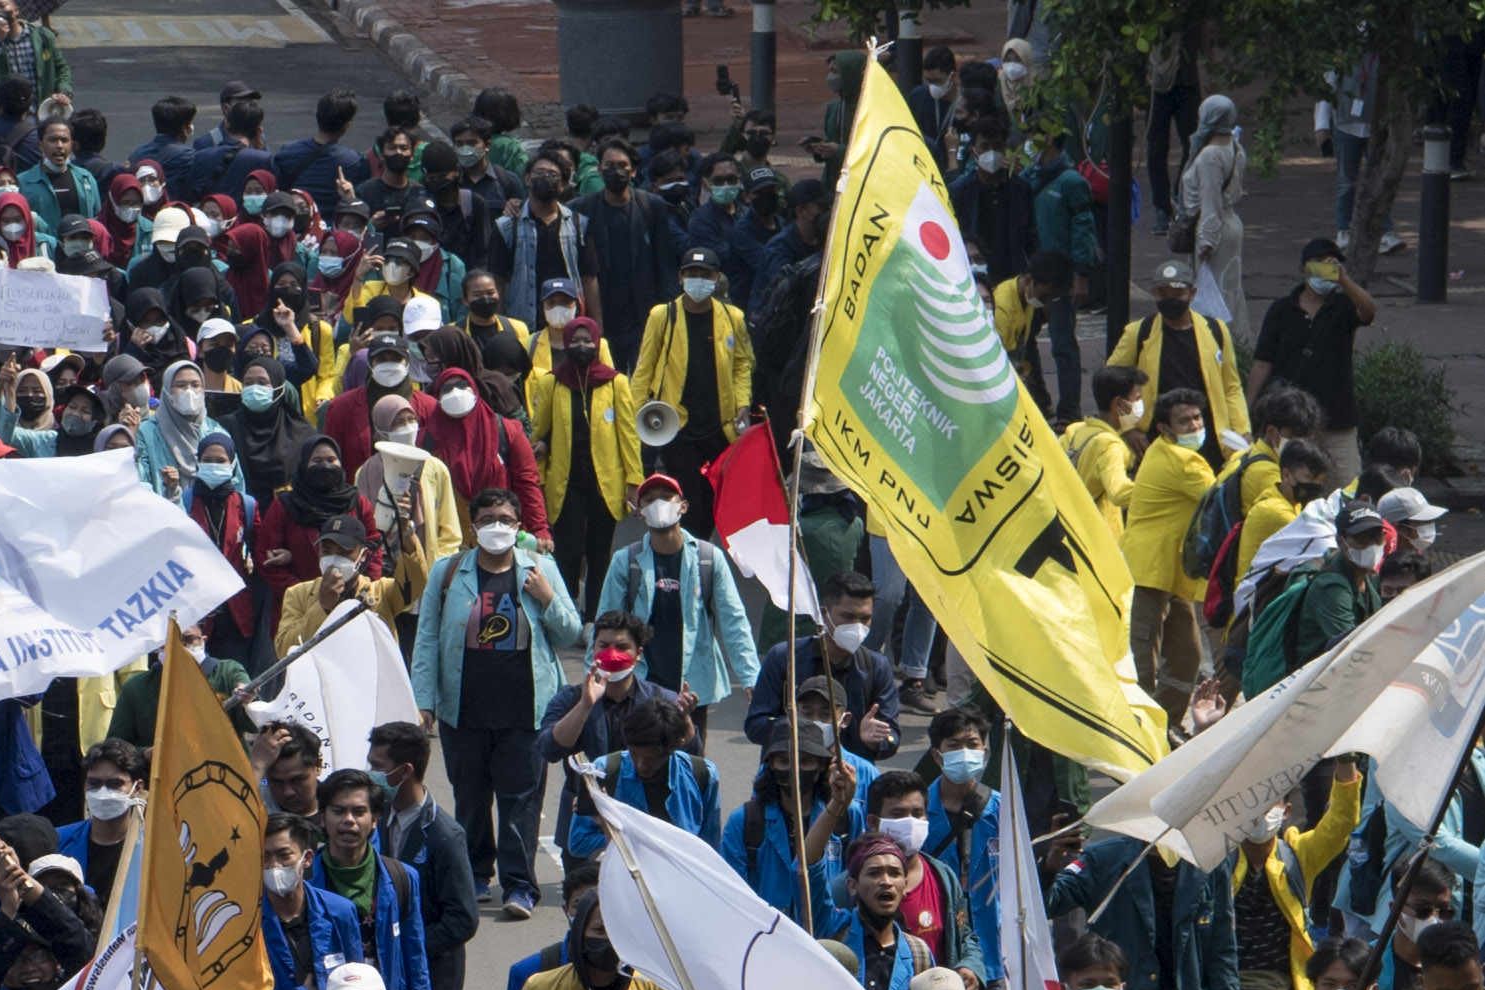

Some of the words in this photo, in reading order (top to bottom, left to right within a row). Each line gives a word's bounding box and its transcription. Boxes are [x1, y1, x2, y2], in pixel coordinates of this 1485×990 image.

[57, 19, 291, 42] MOTO
[843, 203, 891, 321] BADAN
[859, 383, 917, 456] JAKARTA
[868, 361, 917, 425] NEGERI
[876, 345, 960, 442] POLITEKNIK
[834, 410, 871, 468] IKM
[879, 469, 931, 530] PNJ
[7, 628, 105, 666] INSTITUT
[99, 560, 195, 640] TAZKIA
